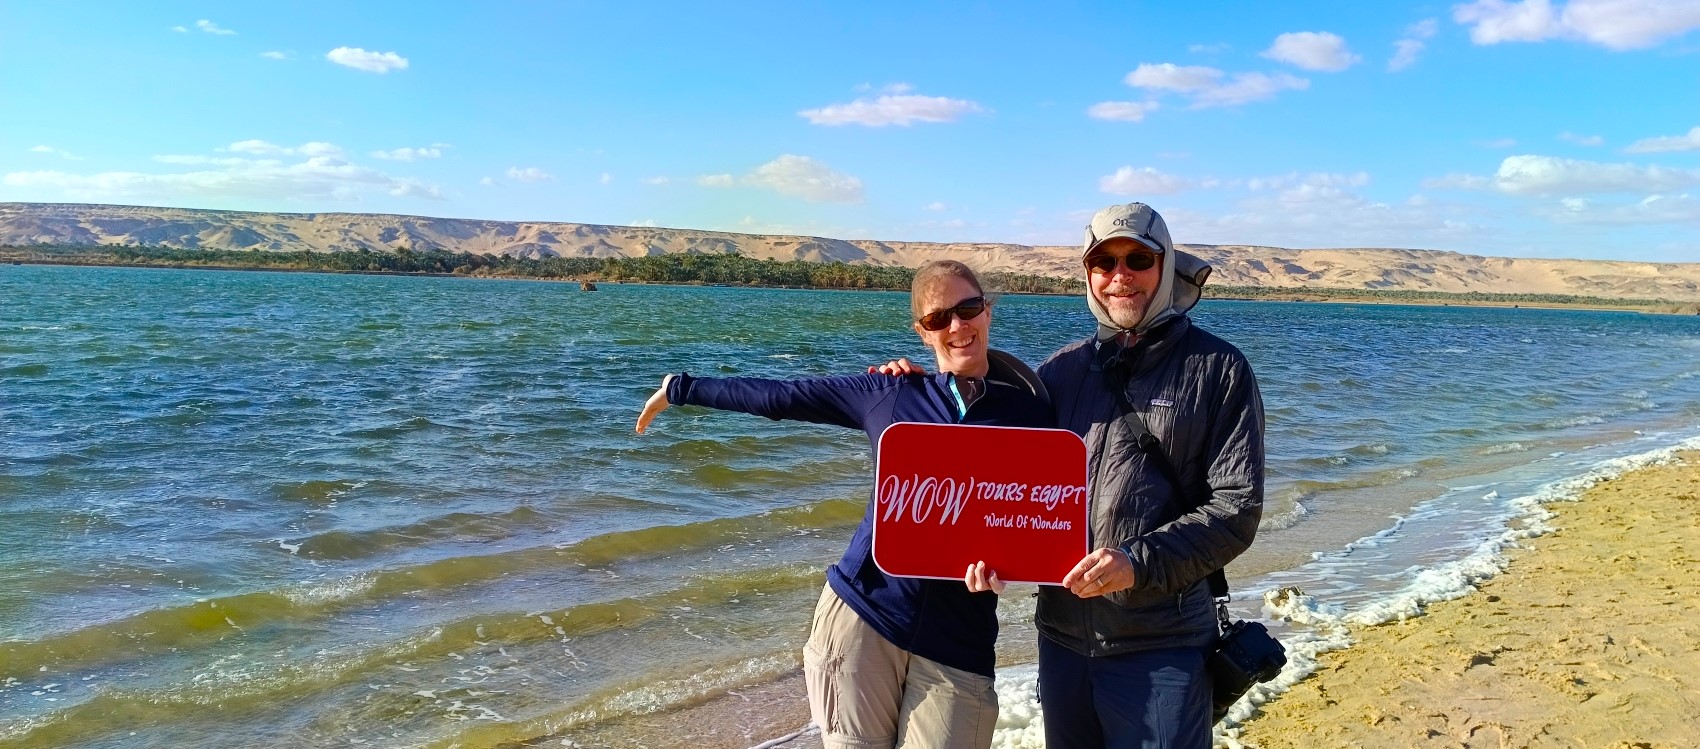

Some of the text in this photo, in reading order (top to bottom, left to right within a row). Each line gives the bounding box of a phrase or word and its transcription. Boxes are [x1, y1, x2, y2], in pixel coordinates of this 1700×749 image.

[1113, 218, 1129, 227] OR
[880, 474, 1085, 525] WOW TOURS EGYPT
[984, 513, 1071, 530] World Of Wonders
